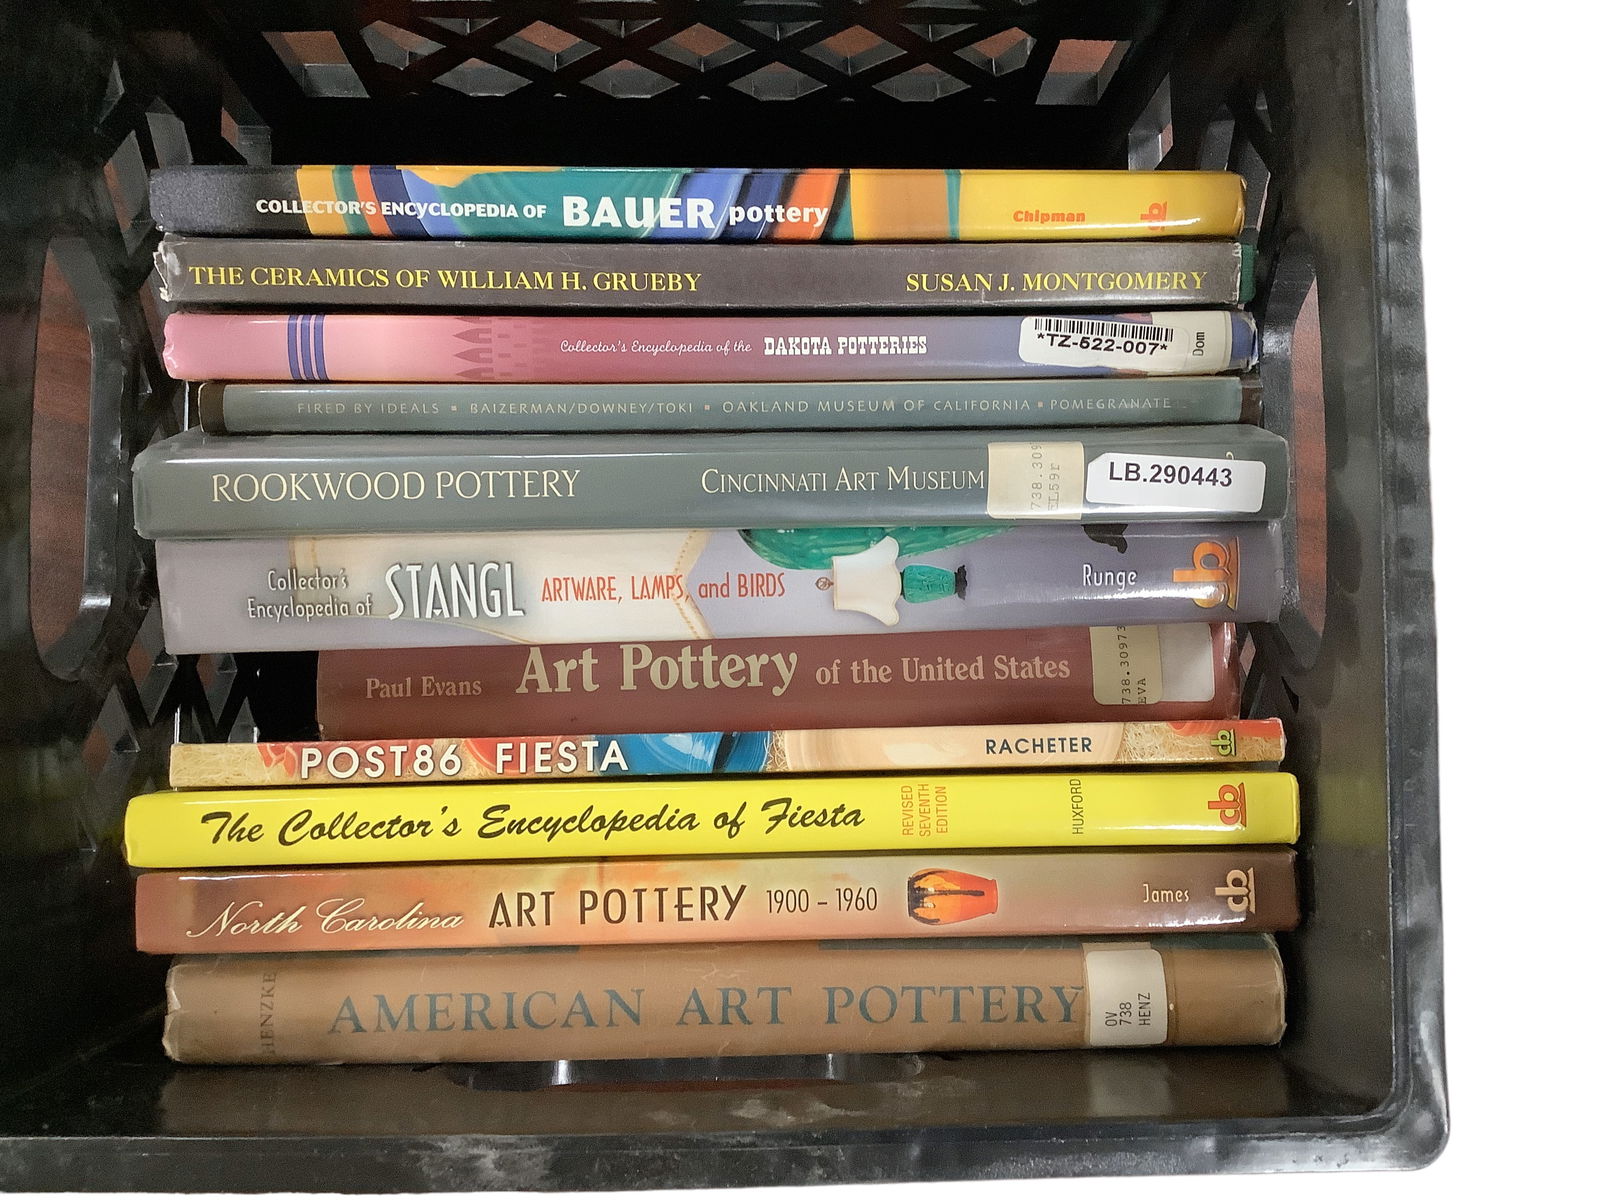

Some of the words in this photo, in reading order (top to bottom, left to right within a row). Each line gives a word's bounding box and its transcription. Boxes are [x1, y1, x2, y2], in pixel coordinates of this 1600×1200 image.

[256, 200, 376, 215] COLLECTOR'S
[381, 201, 518, 220] ENCYCLOPEDIA
[523, 203, 547, 219] OF
[562, 194, 716, 231] BAUER
[729, 203, 829, 228] pottery
[1013, 210, 1085, 225] Chipman
[189, 265, 245, 286] THE
[250, 266, 390, 288] CERAMICS
[395, 268, 431, 289] OF
[437, 270, 554, 290] WILLIAM
[561, 271, 588, 291] H.
[592, 272, 702, 293] GRUEBY
[906, 272, 994, 293] SUSAN
[997, 273, 1015, 293] J.
[1021, 270, 1208, 292] MONTGOMERY
[560, 339, 627, 353] Collector's
[629, 342, 711, 356] Encyclopedia
[716, 340, 731, 356] of
[733, 340, 752, 353] the
[763, 337, 834, 355] DAKOTA
[838, 336, 928, 355] POTTERIES
[1192, 331, 1206, 357] Dom
[297, 403, 349, 415] FIRED
[353, 403, 375, 415] BY
[380, 402, 440, 414] IDEALS
[470, 402, 694, 415] BAIZERMAN/DOWNEY/TOKI
[722, 401, 808, 413] OAKLAND
[817, 400, 896, 412] MUSEUM
[903, 400, 926, 412] OF
[933, 399, 1031, 411] CALIFORNIA
[1050, 397, 1172, 410] POMEGRANATE
[212, 471, 426, 503] ROOKWOOD
[436, 470, 581, 499] POTTERY
[701, 468, 827, 494] CINCINNATI
[835, 467, 880, 492] ART
[887, 466, 985, 491] MUSEUM
[1109, 461, 1233, 487] LB.290443
[268, 569, 348, 591] Collector's
[386, 562, 525, 620] STANGL
[541, 576, 623, 604] ARTWARE,
[631, 574, 689, 601] LAMPS,
[698, 574, 730, 599] and
[737, 572, 786, 598] BIRDS
[1083, 564, 1138, 590] Runge
[248, 598, 349, 622] Encyclopedia
[356, 594, 374, 618] of
[516, 647, 600, 694] Art
[620, 645, 798, 696] Pottery
[815, 661, 839, 684] of
[851, 659, 892, 683] the
[902, 656, 985, 683] United
[994, 655, 1071, 680] States
[366, 678, 412, 698] Paul
[421, 676, 482, 697] Evans
[1137, 678, 1147, 704] EVA
[985, 737, 1093, 754] RACHETER
[300, 745, 462, 780] POST86
[496, 740, 628, 774] FIESTA
[901, 785, 914, 836] REVISED
[918, 784, 931, 837] SEVENTH
[935, 786, 948, 833] EDITION
[1069, 778, 1084, 834] HUXFORD
[201, 812, 263, 846] The
[278, 805, 461, 846] Collector's
[478, 804, 698, 843] Encyclopedia
[713, 802, 747, 838] of
[761, 797, 865, 834] Fiesta
[488, 891, 556, 929] ART
[578, 885, 746, 925] POTTERY
[766, 889, 810, 914] 1900
[835, 886, 878, 912] 1960
[1143, 883, 1190, 903] James
[187, 901, 303, 938] North
[315, 897, 465, 934] Carolina
[328, 989, 645, 1035] AMERICAN
[675, 985, 793, 1029] ART
[825, 985, 1084, 1025] POTTERY
[1119, 1001, 1132, 1026] 738
[1138, 992, 1151, 1026] HENZ
